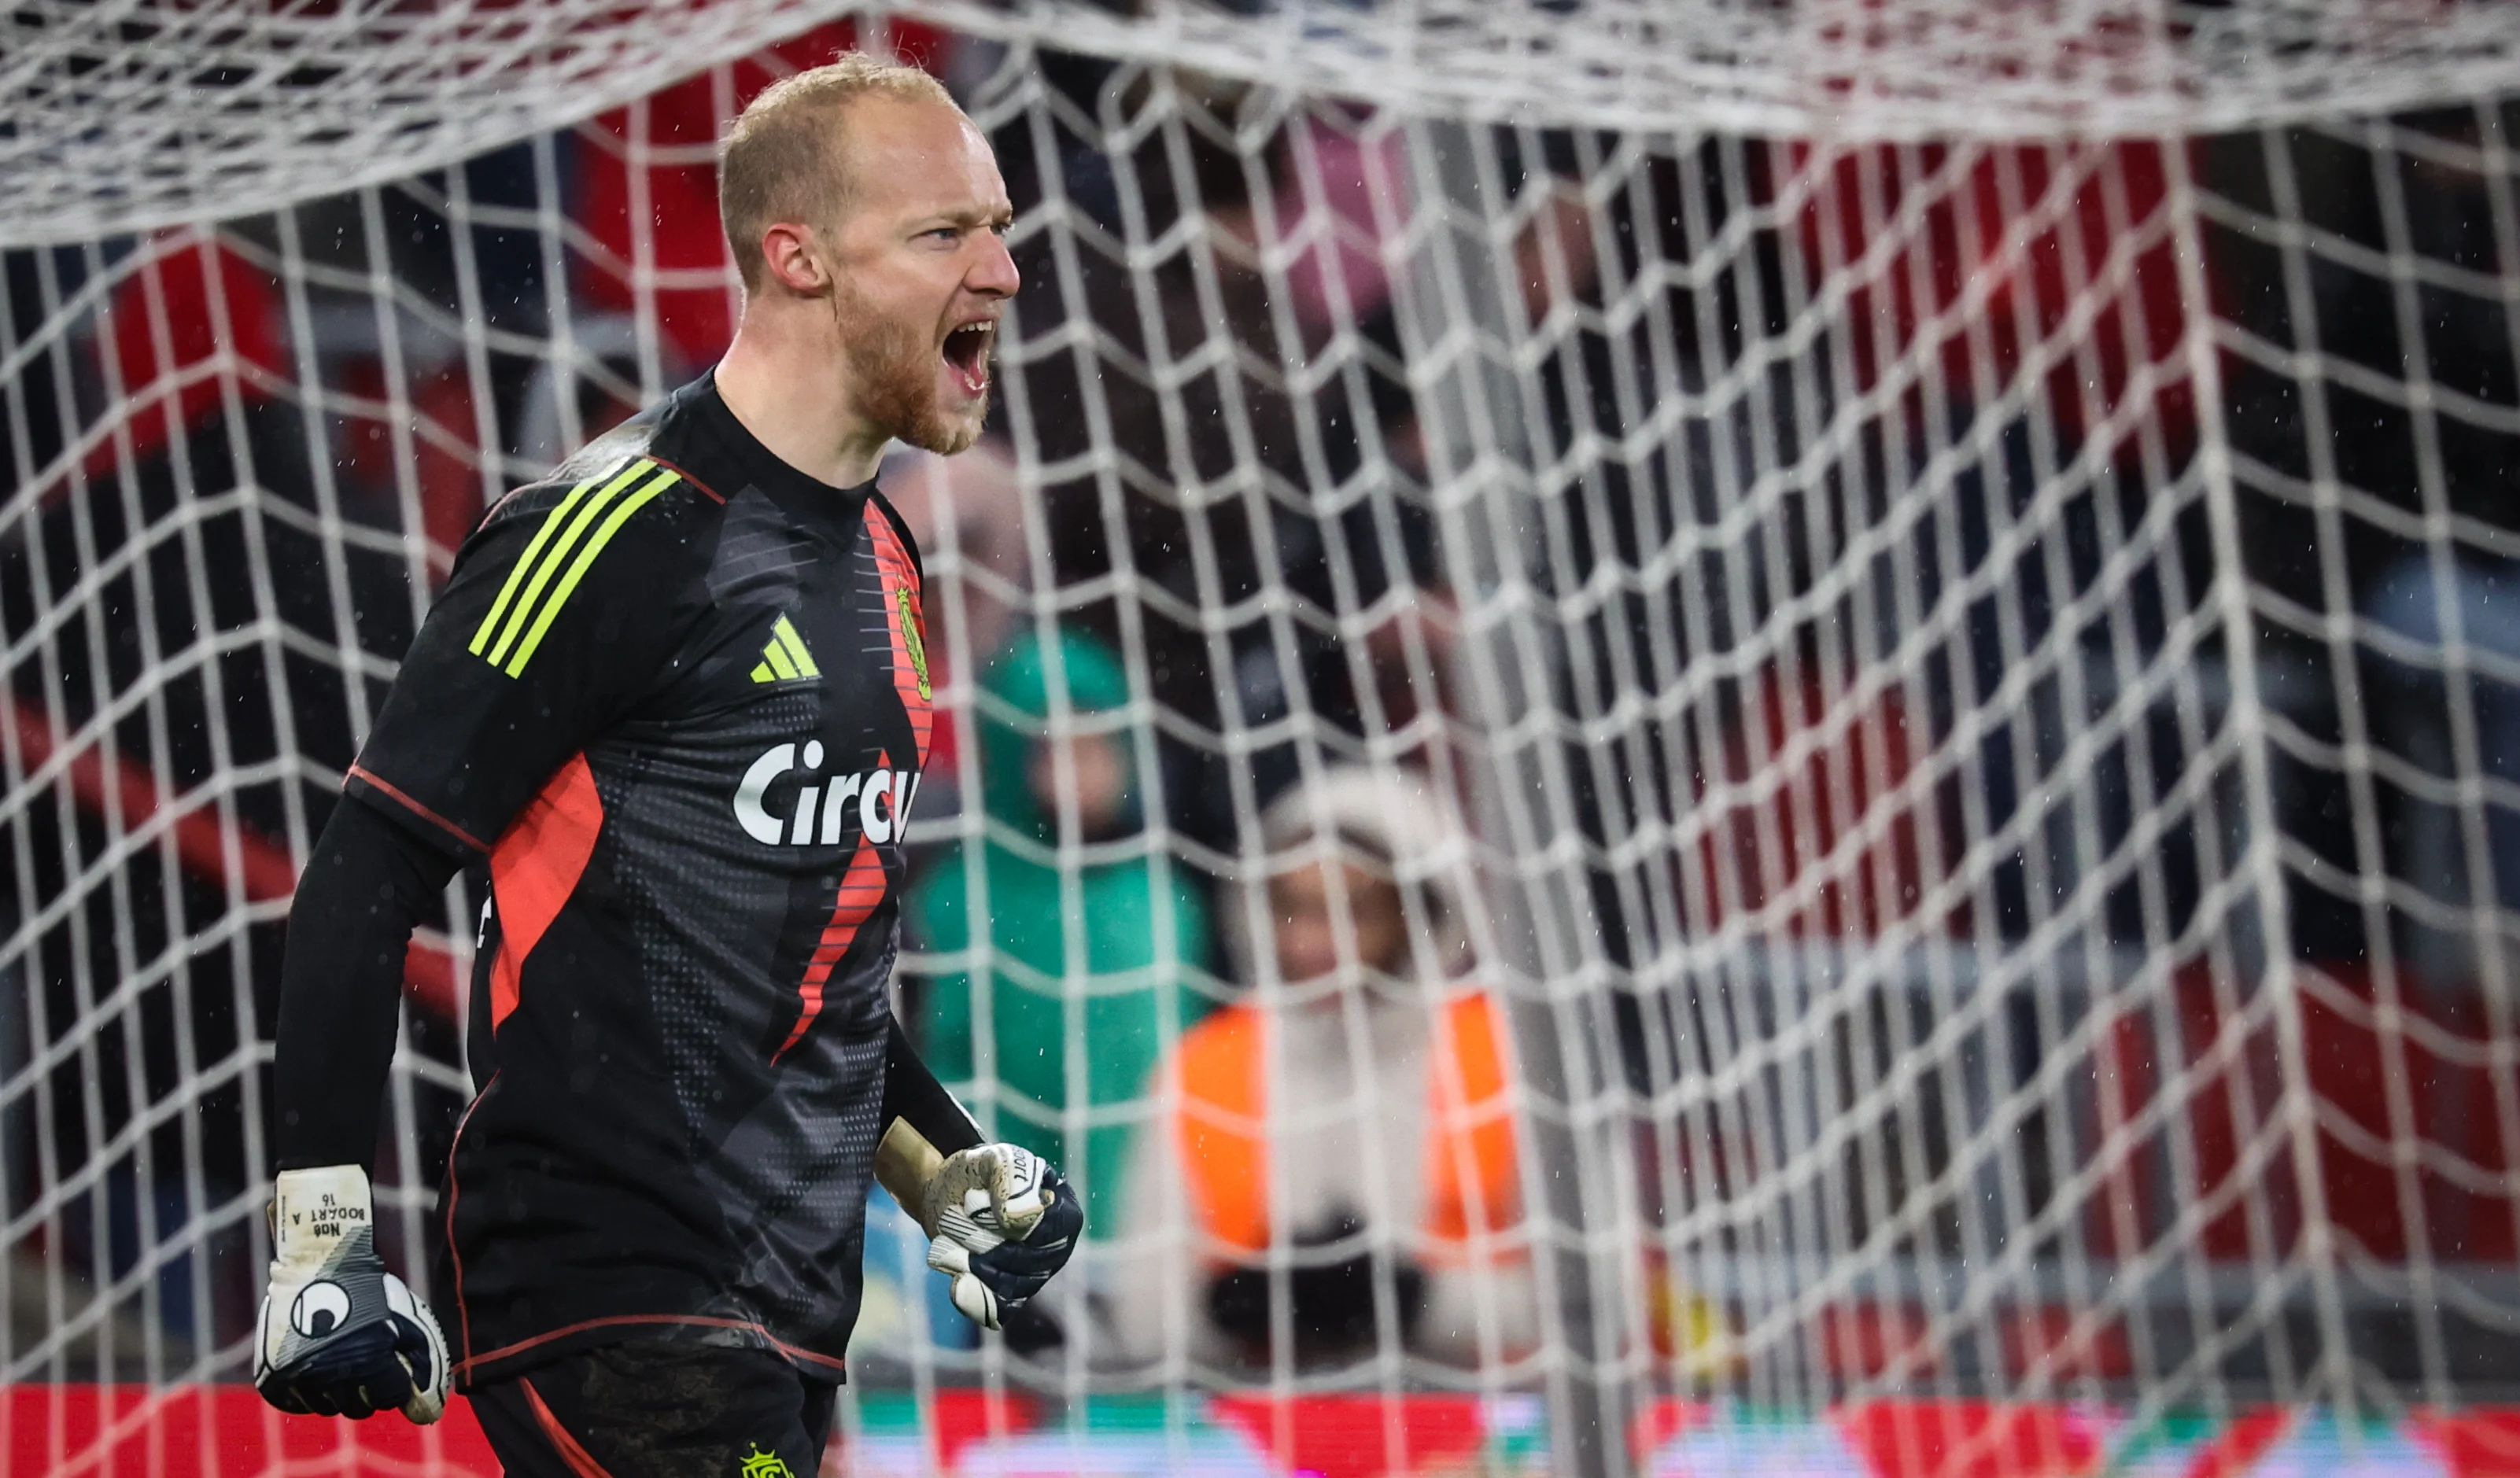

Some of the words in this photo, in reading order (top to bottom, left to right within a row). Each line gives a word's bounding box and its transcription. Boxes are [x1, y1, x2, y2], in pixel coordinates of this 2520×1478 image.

[322, 1192, 336, 1207] 16
[292, 1212, 301, 1226] A
[311, 1207, 366, 1222] BODART
